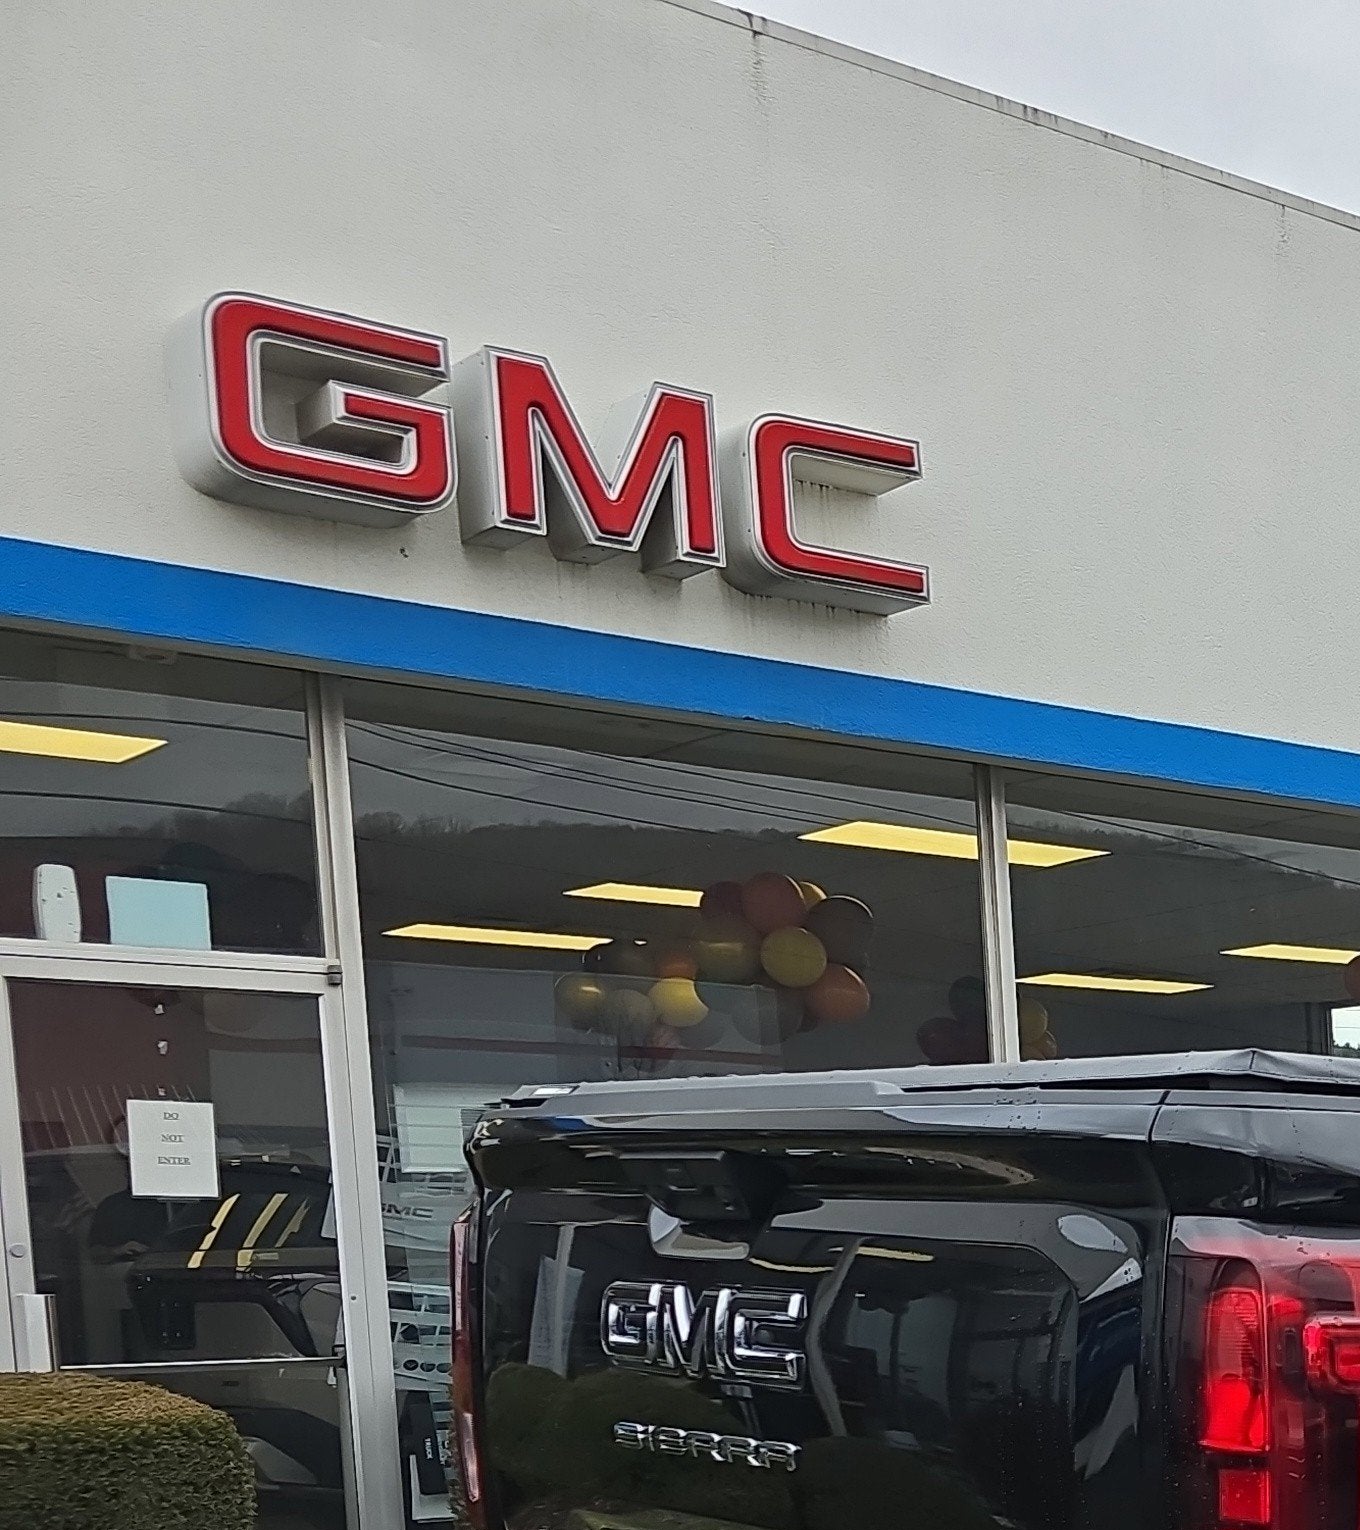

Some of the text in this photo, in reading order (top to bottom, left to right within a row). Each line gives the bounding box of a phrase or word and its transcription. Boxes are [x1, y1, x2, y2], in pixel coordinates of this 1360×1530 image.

[200, 290, 932, 606] GMC
[163, 1111, 180, 1121] DO
[161, 1133, 185, 1143] NOT
[157, 1156, 191, 1166] ENTER
[600, 1279, 808, 1390] GMC
[613, 1421, 803, 1472] SIERRA
